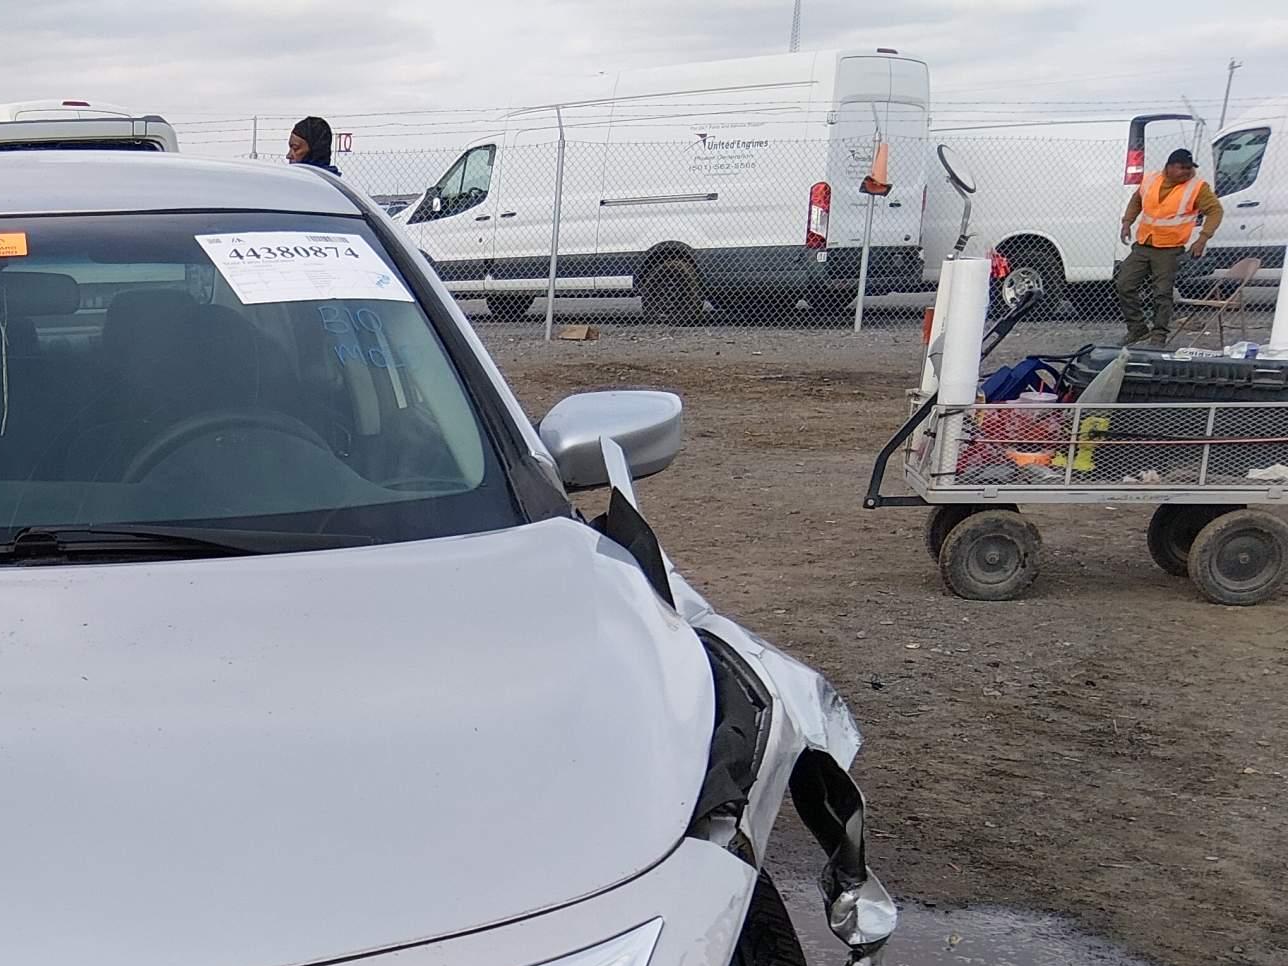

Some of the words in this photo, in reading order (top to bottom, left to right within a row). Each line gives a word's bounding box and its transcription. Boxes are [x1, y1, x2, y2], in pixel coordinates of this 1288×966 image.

[707, 140, 734, 150] United
[736, 139, 768, 149] Engines
[228, 245, 360, 260] 44380874
